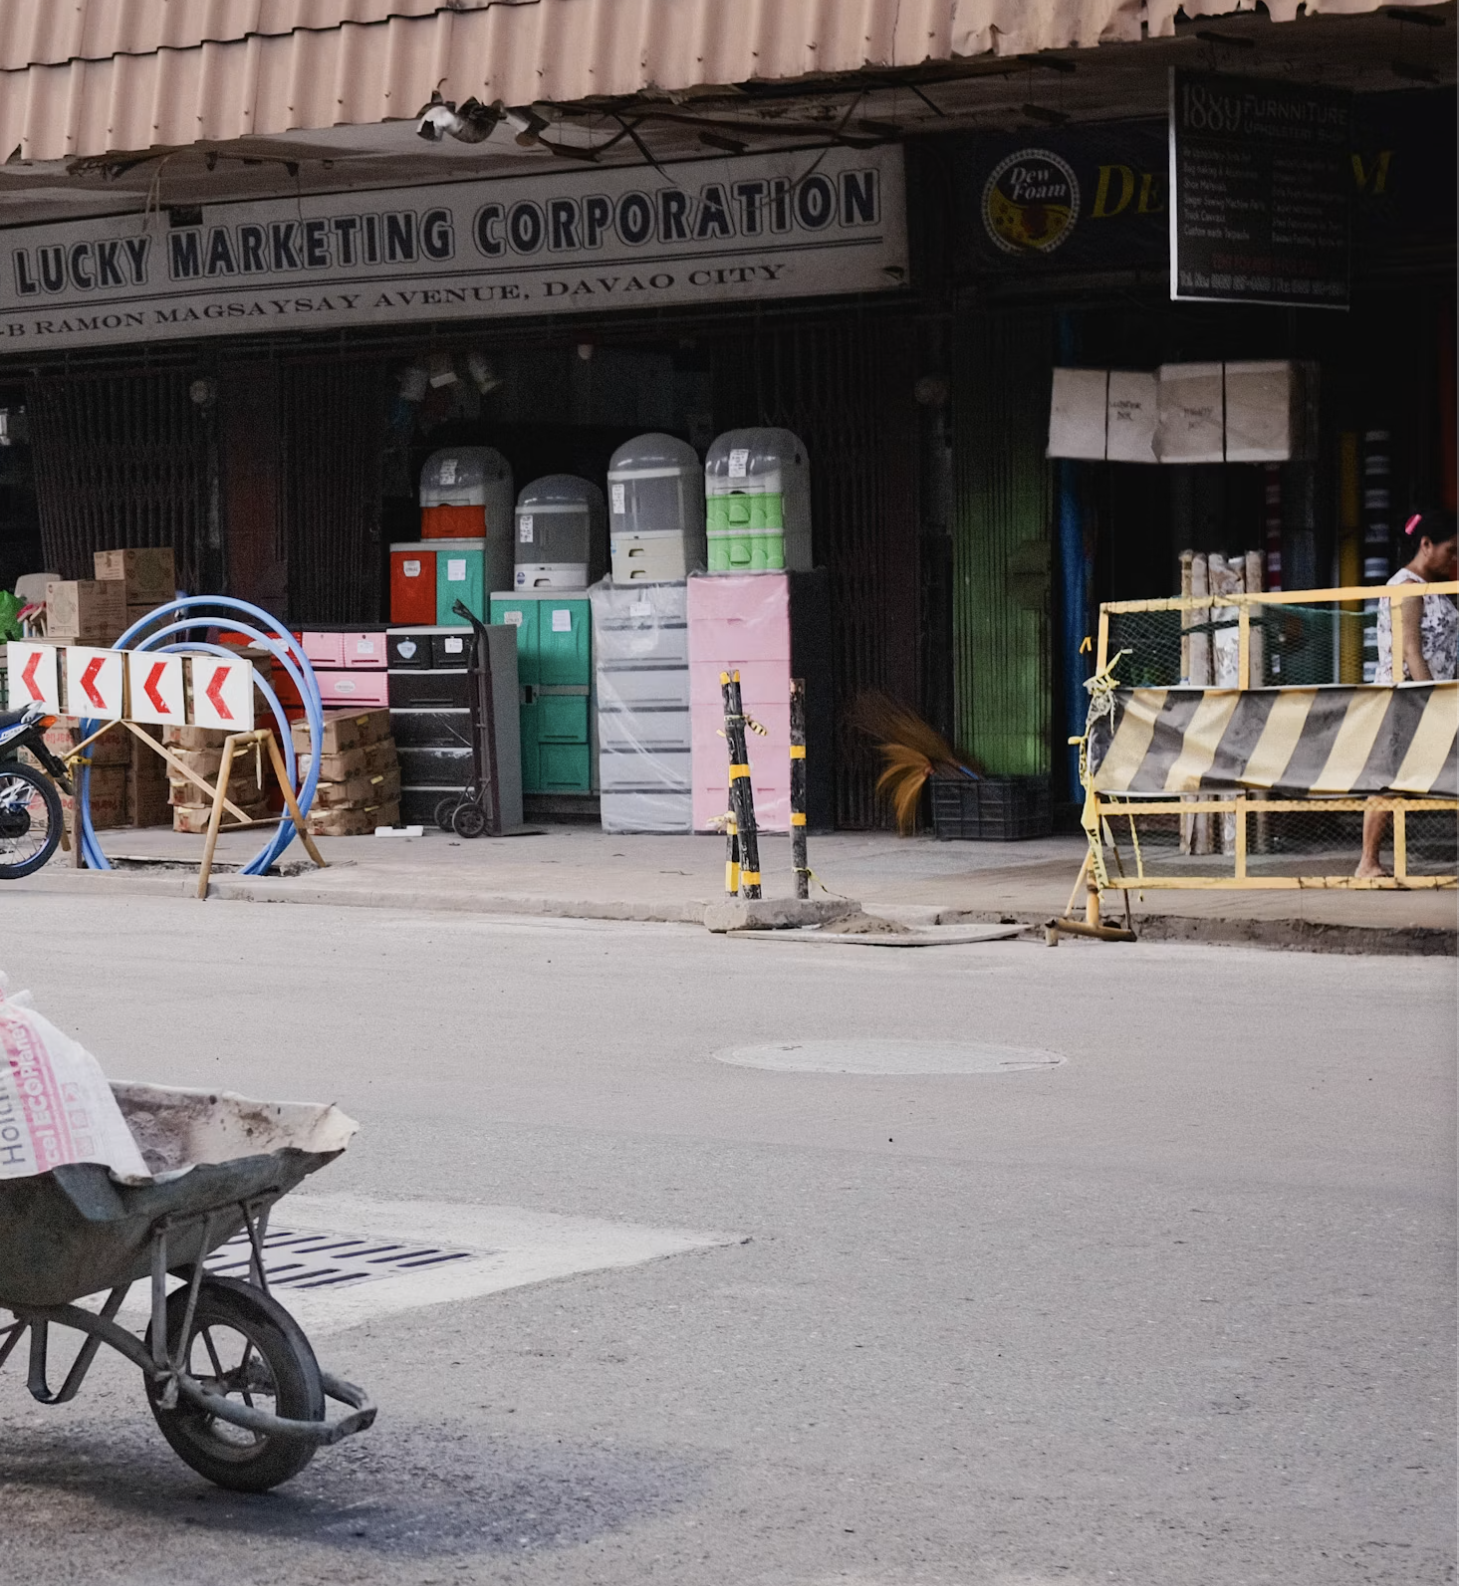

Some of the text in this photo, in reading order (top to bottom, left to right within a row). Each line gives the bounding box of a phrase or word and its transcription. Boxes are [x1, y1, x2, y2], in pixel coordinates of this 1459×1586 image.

[1182, 83, 1241, 131] 1889
[1010, 167, 1052, 186] Dew
[1013, 182, 1067, 201] Foam
[1091, 164, 1167, 218] DE
[13, 236, 152, 296] LUCKY
[168, 207, 455, 281] MARKETING
[473, 168, 880, 258] CORPORATION
[36, 312, 144, 335] RAMON
[154, 294, 360, 323] MAGSAYSAY
[374, 284, 531, 307] AVENUE,
[543, 272, 676, 298] DAVAO
[688, 264, 786, 286] CITY
